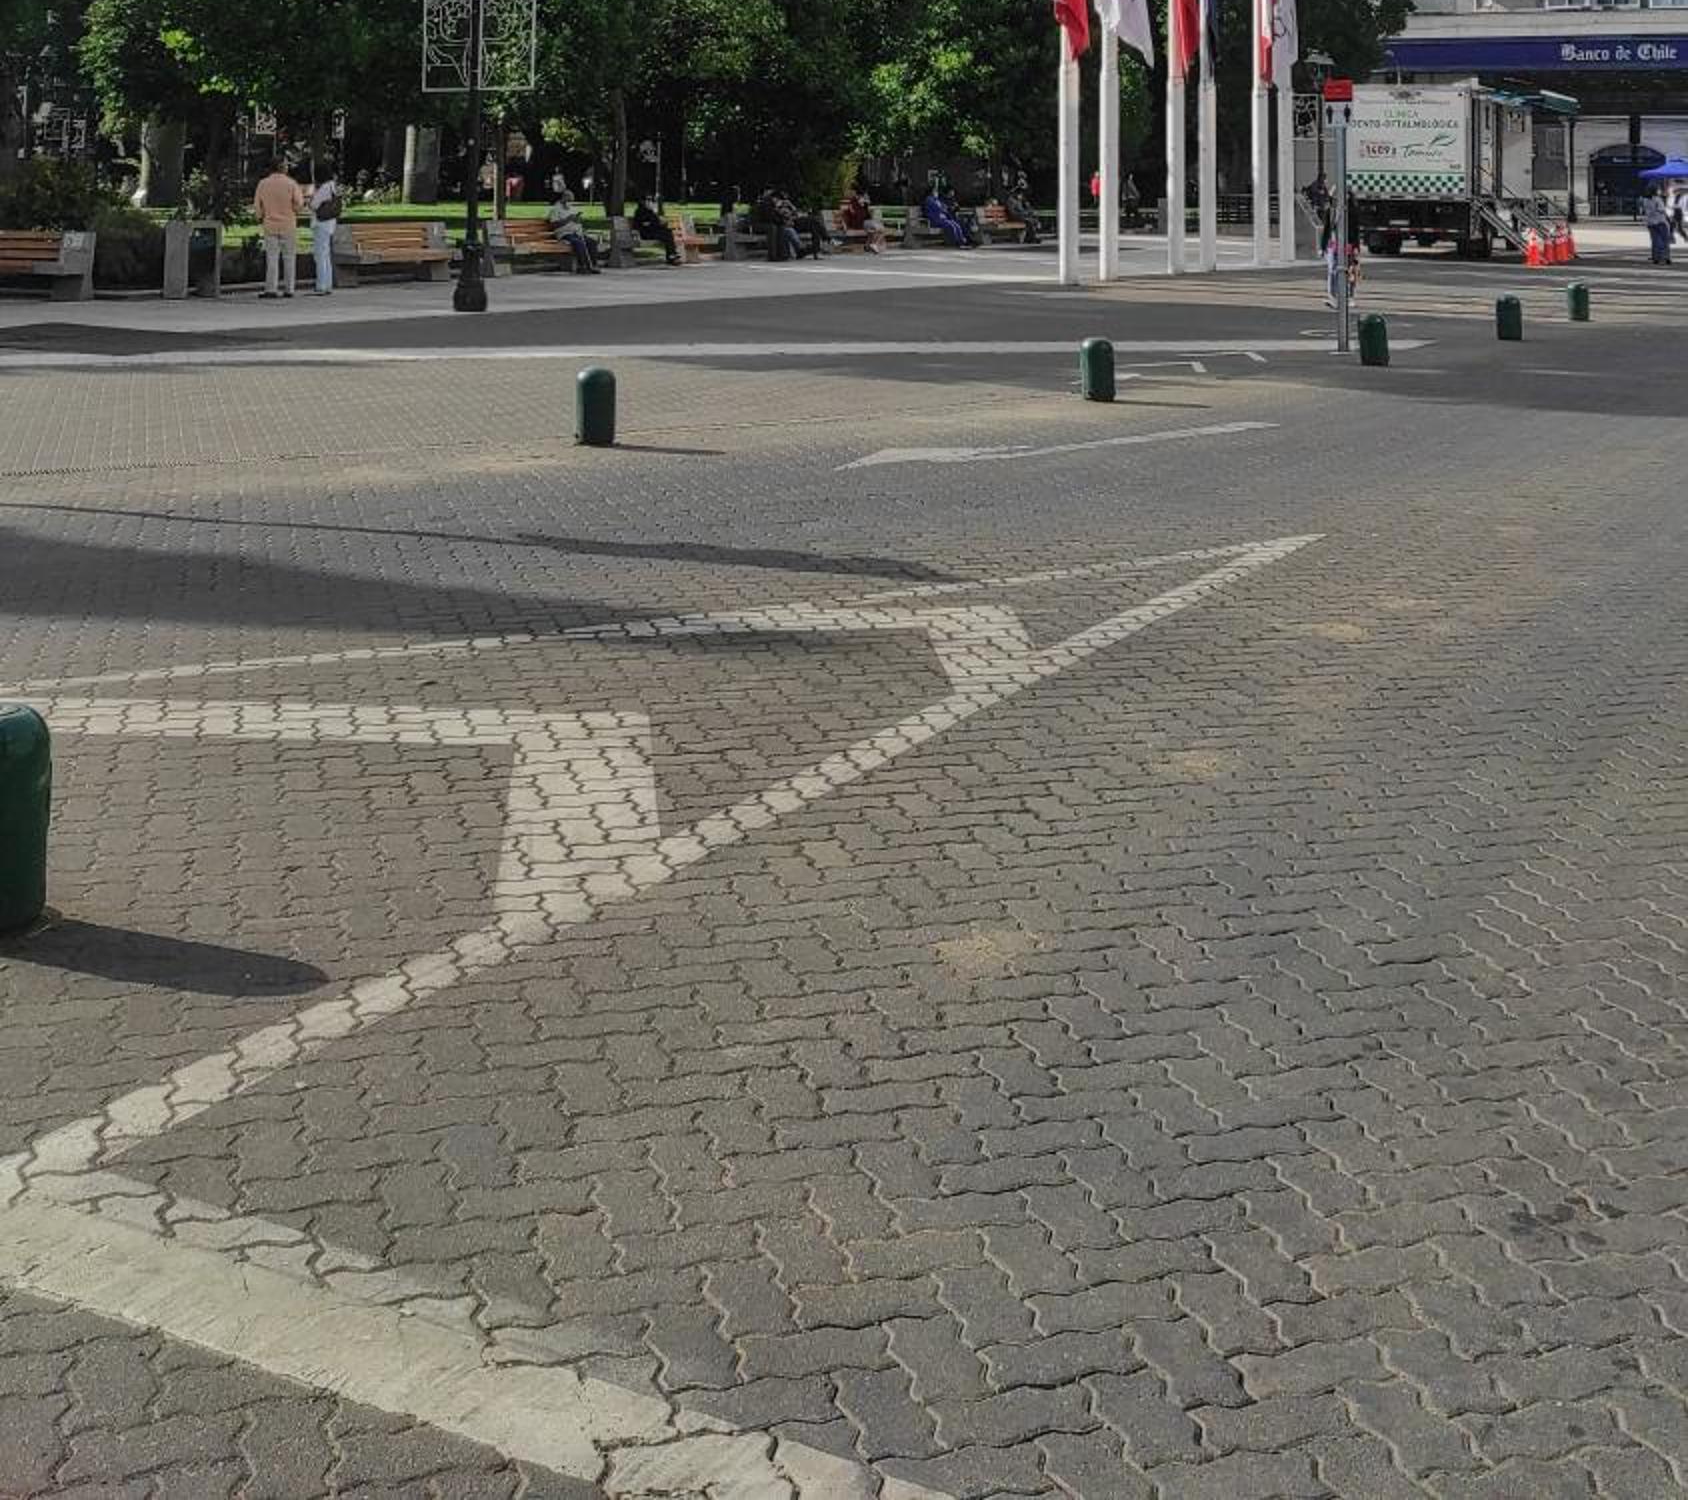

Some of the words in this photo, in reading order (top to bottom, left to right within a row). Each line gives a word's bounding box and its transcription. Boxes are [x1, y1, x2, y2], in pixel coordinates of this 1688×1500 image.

[1561, 43, 1610, 61] Banco
[1615, 44, 1633, 61] de
[1636, 43, 1678, 60] Chile
